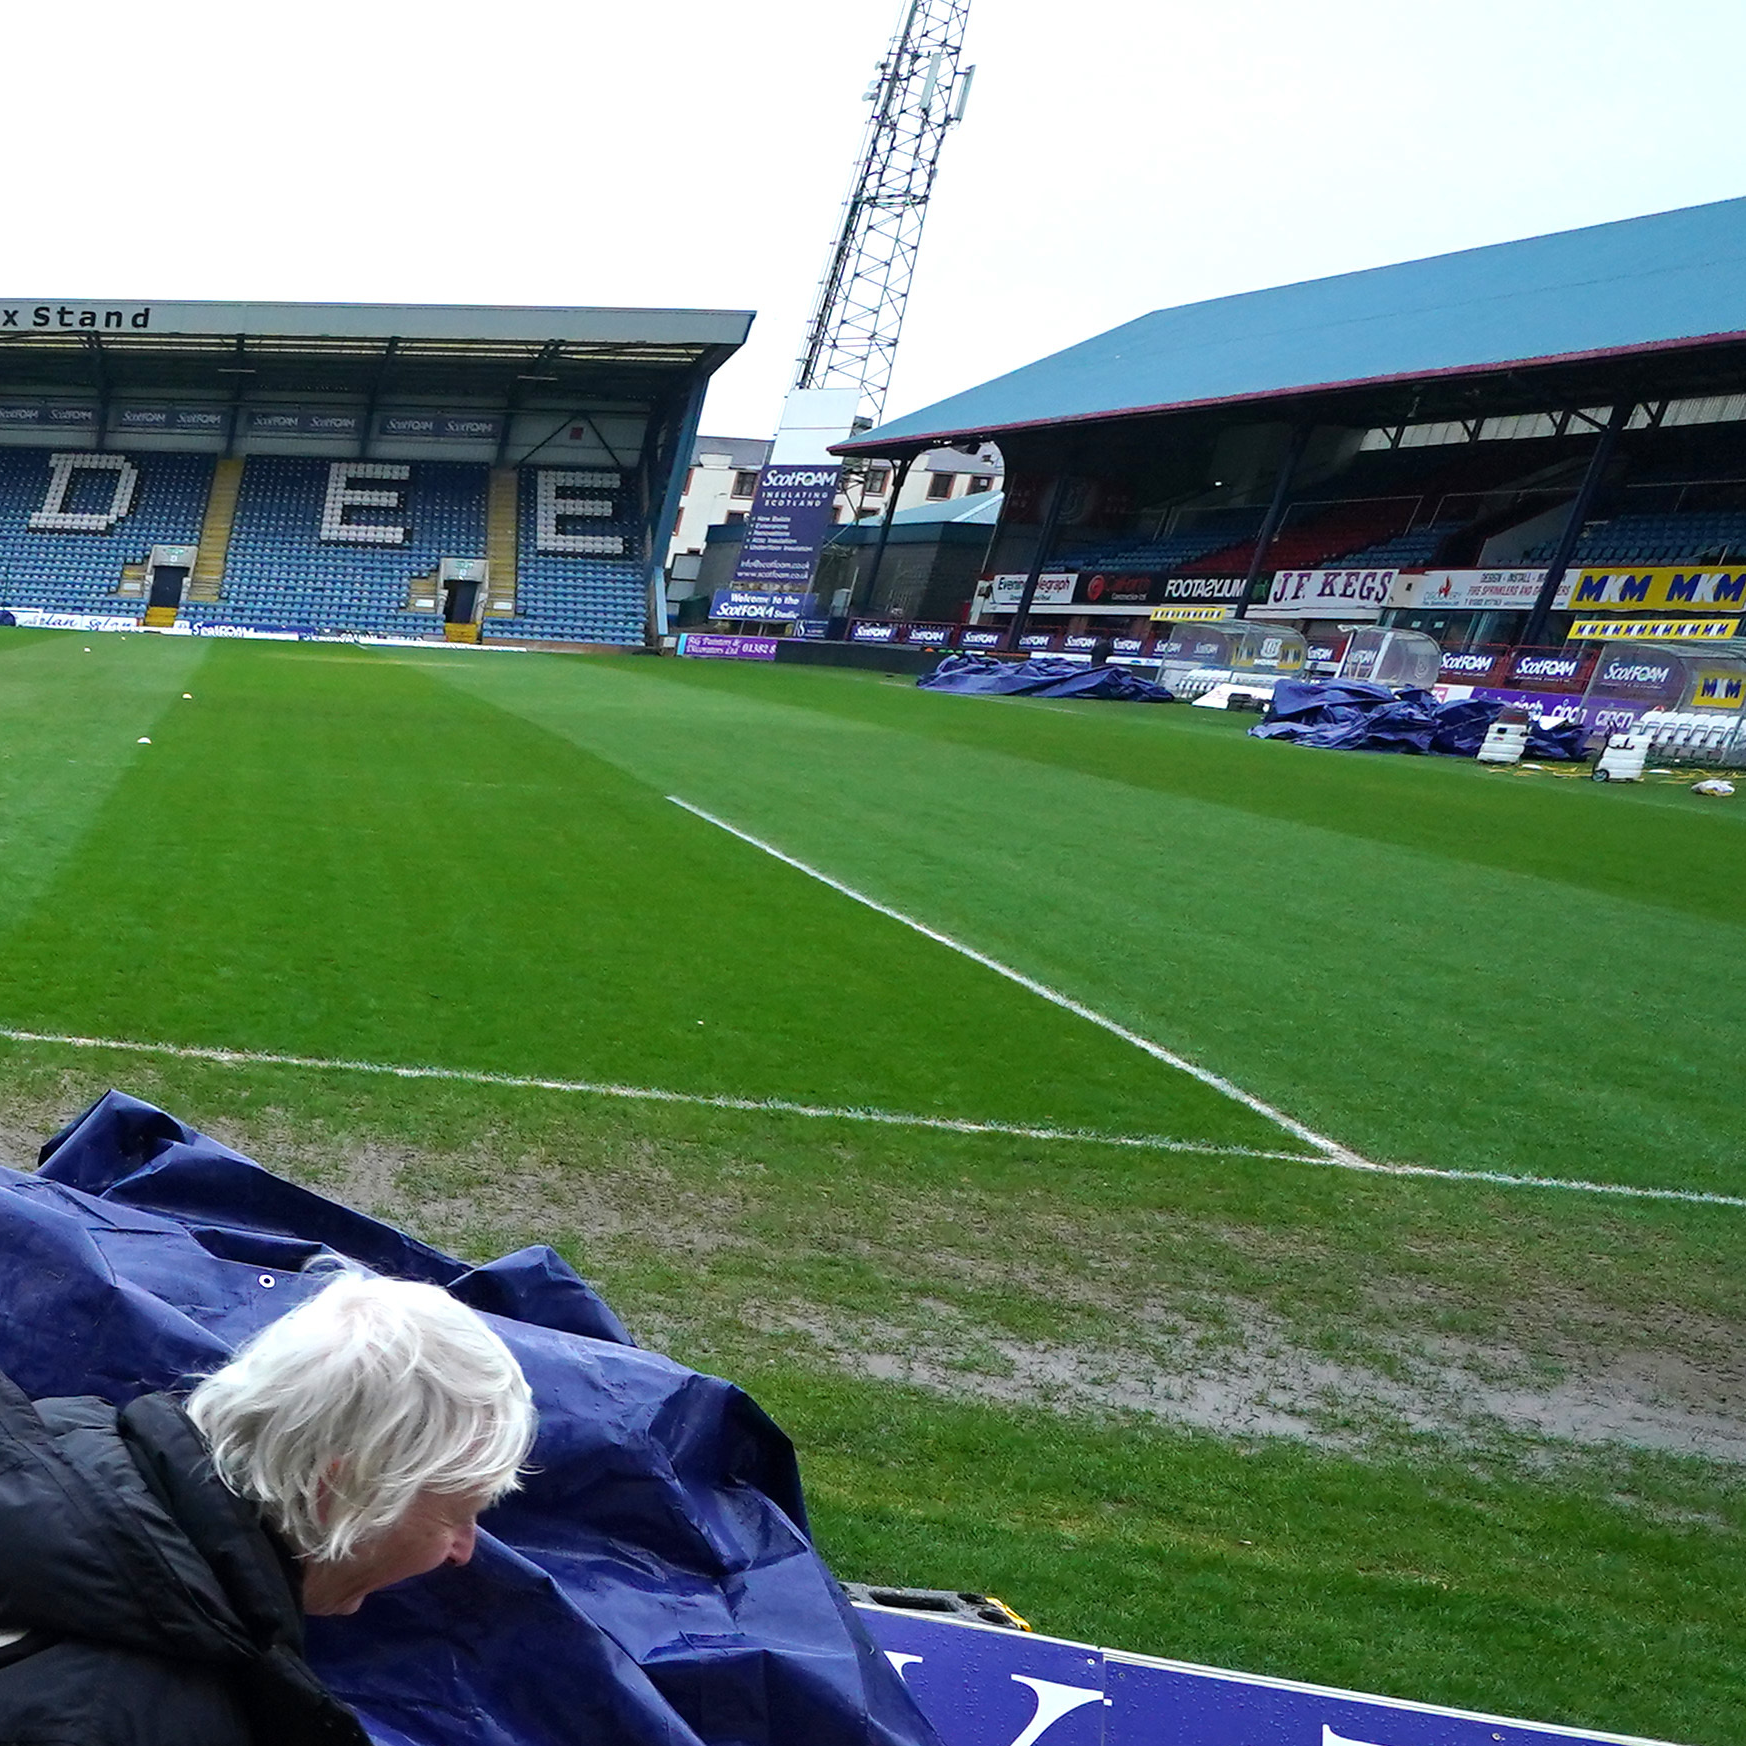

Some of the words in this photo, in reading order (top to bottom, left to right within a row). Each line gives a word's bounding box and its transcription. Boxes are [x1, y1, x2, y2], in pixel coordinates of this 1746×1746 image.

[32, 306, 151, 329] Stand
[761, 469, 838, 487] ScotFOAM
[761, 491, 829, 499] INSULATING
[764, 499, 822, 507] SCOTLAND
[1164, 578, 1247, 598] FOOTASYLUM
[1273, 572, 1312, 603] J.F.
[1317, 571, 1394, 604] KEGS
[1575, 574, 1654, 603] MKM
[1665, 573, 1746, 603] MKM
[731, 592, 769, 604] Welcome
[772, 596, 782, 605] to
[784, 595, 800, 605] the
[1440, 653, 1493, 671] ScotFOAM
[1516, 657, 1577, 677] ScotFOAM
[1603, 662, 1670, 683] ScotFOAM
[1701, 677, 1742, 699] MKM
